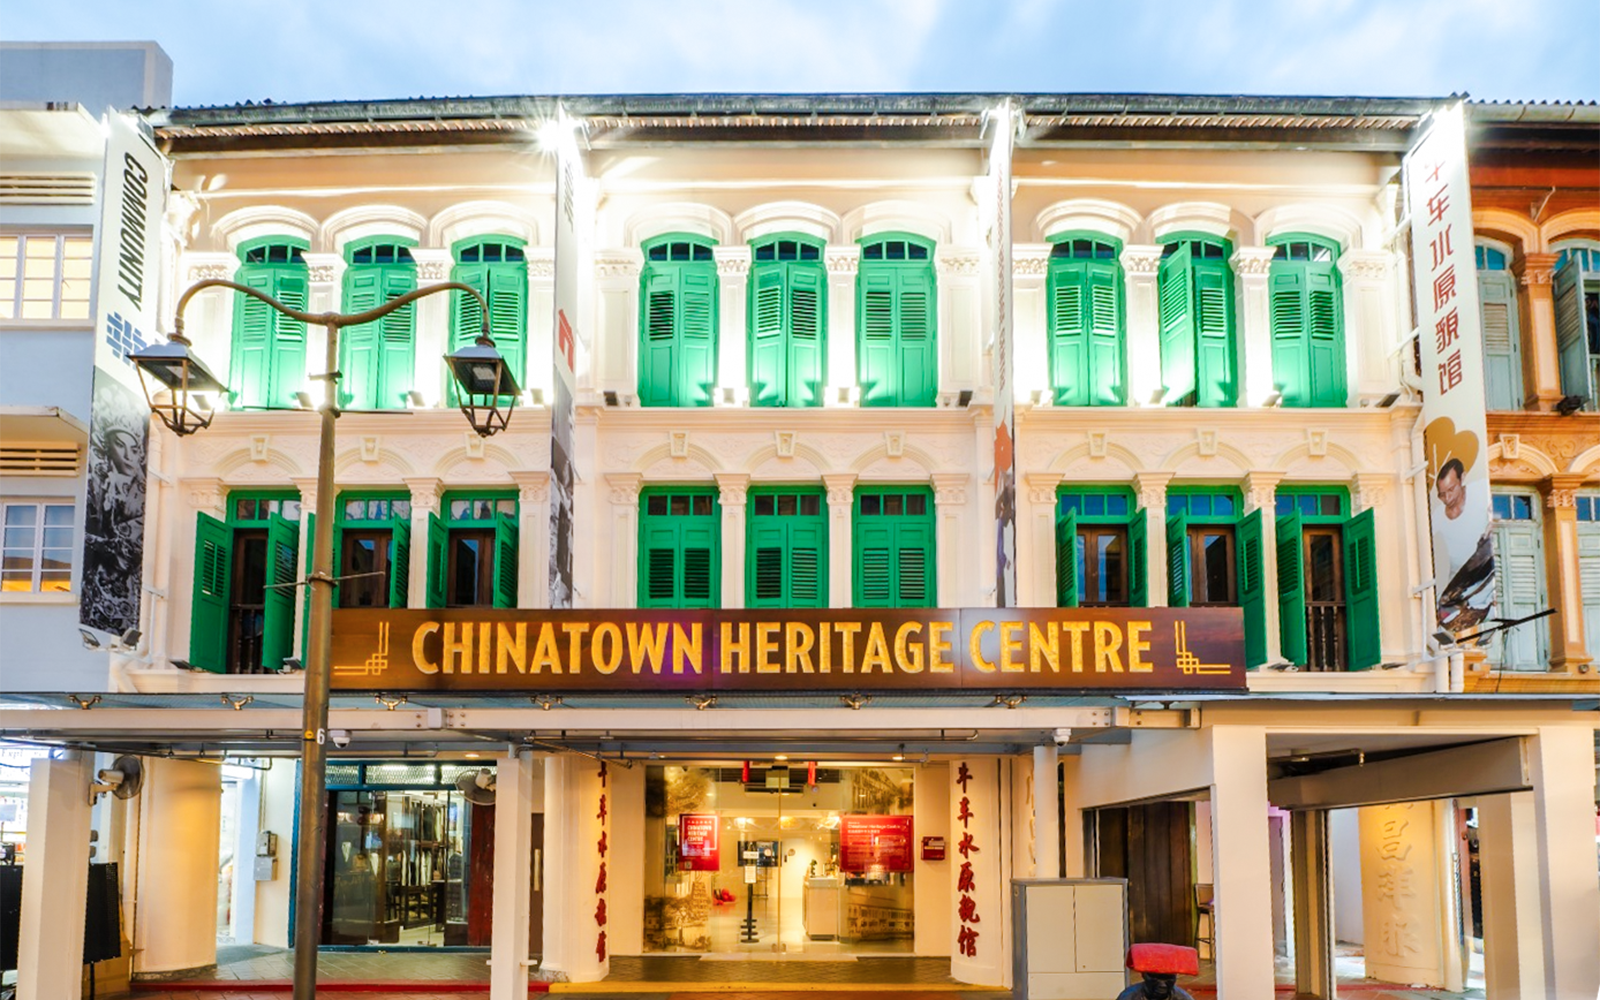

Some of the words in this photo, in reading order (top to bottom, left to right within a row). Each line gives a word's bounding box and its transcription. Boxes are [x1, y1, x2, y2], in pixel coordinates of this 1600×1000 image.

[117, 151, 149, 312] COMMUNITY
[412, 621, 703, 675] CHINATOWN
[720, 621, 954, 674] HERITAGE
[969, 620, 1153, 674] CENTRE
[316, 728, 326, 745] 6
